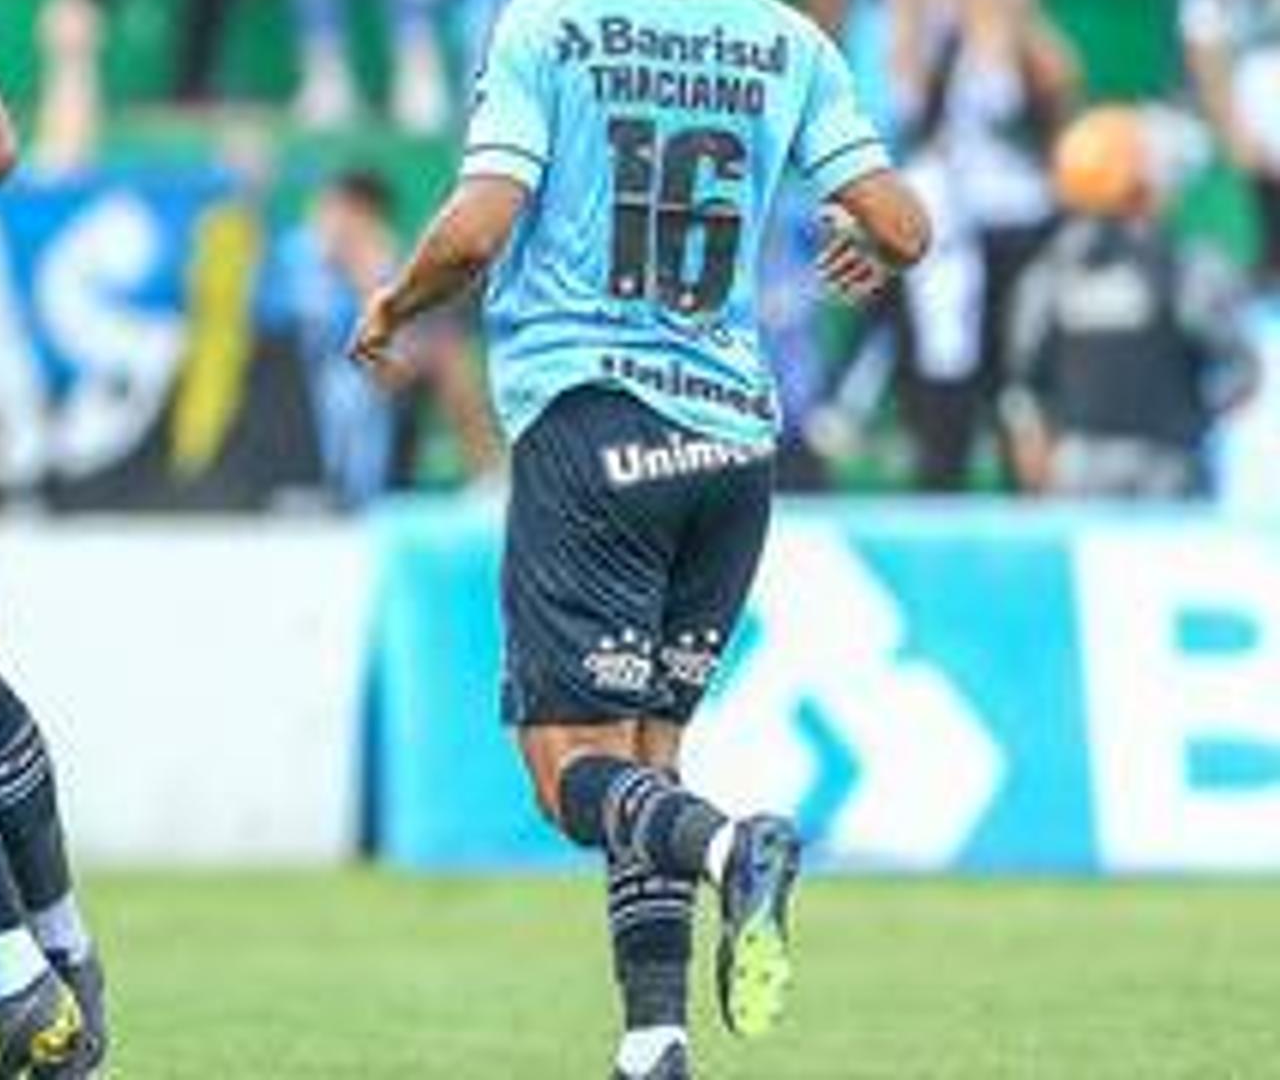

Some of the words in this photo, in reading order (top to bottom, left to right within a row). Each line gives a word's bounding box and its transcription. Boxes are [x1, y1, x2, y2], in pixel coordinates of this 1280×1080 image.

[601, 16, 787, 74] Banrisul
[590, 66, 765, 115] THACIANO
[608, 118, 747, 314] 16
